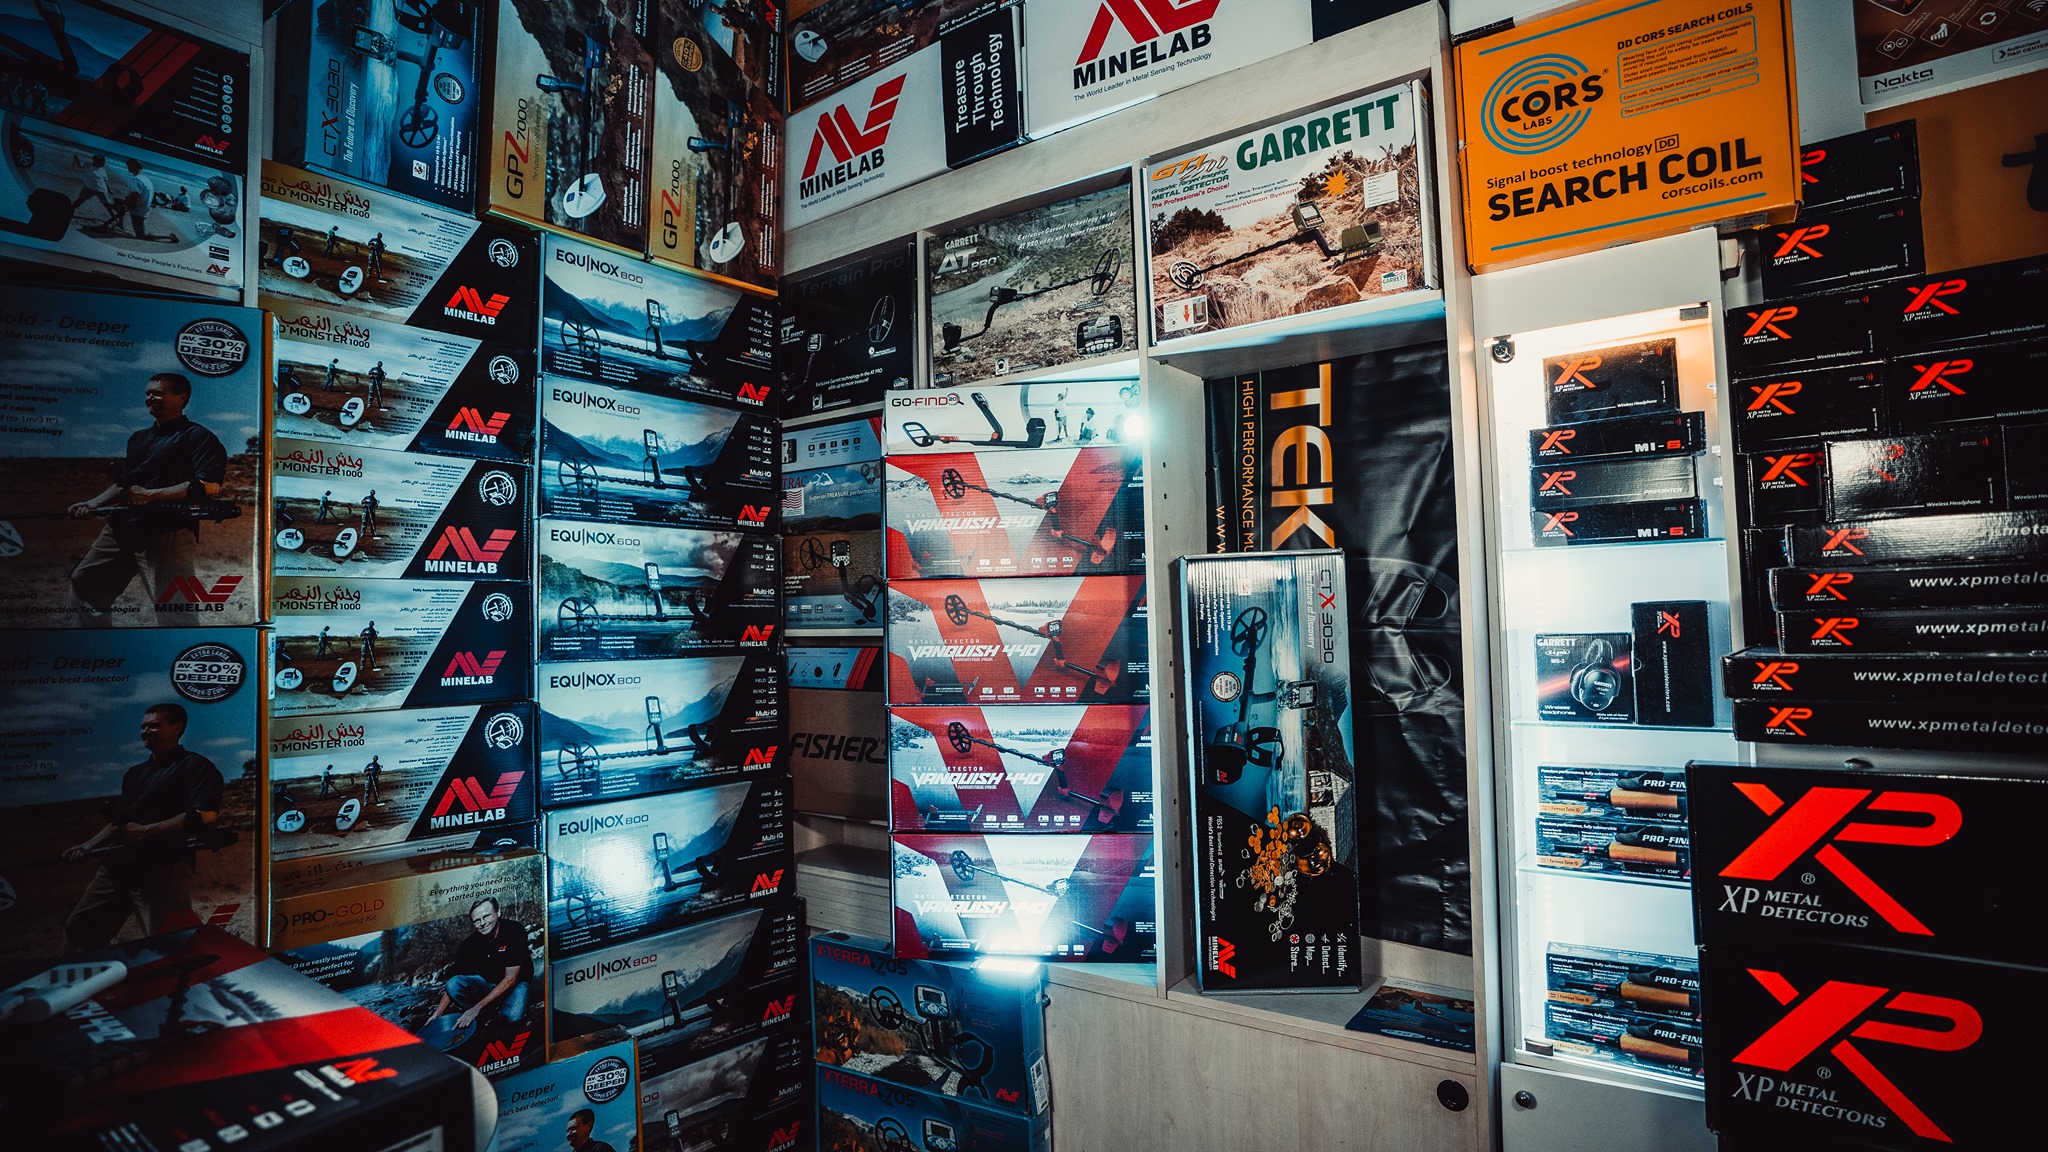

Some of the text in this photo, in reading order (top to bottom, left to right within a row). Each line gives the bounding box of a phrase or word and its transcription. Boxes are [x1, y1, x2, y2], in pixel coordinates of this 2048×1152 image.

[1618, 2, 1753, 50] DD CORS SEARCH COILS
[1622, 52, 1644, 62] Wearing
[1677, 38, 1692, 47] using
[1694, 30, 1724, 43] composite
[1724, 21, 1752, 32] materials
[2006, 40, 2040, 53] Authorized
[1073, 24, 1212, 90] MINELAB
[988, 32, 1004, 131] Technology
[1074, 93, 1085, 101] The
[1086, 88, 1103, 97] World
[1104, 81, 1124, 92] Leader
[1132, 72, 1149, 82] Metal
[1150, 64, 1175, 77] Sensing
[1176, 52, 1212, 68] Technology
[1874, 69, 1934, 90] Nokta
[347, 81, 359, 114] Discovery
[955, 59, 968, 134] Treasure
[969, 52, 986, 125] Through
[1501, 74, 1604, 123] CORS
[1650, 97, 1680, 108] completely
[1680, 88, 1711, 100] waterproof
[516, 98, 528, 140] 7000
[1523, 116, 1553, 131] LABS
[345, 126, 355, 148] Future
[1236, 93, 1400, 171] GARRETT
[194, 143, 224, 155] MINELAB
[1486, 136, 1677, 189] Signal boost technology DD
[799, 148, 885, 200] MINELAB
[1488, 137, 1762, 222] SEARCH COIL
[1151, 175, 1229, 201] METAL DETECTOR
[1661, 169, 1764, 201] corscoils.com
[1845, 186, 1894, 201] Wireless Headphone
[1151, 182, 1230, 209] The Professional's Choice!
[944, 234, 979, 250] GARRETT
[127, 253, 151, 264] Change
[177, 264, 202, 273] Fortunes
[556, 249, 643, 284] EQUINOX 800
[934, 247, 997, 280] AT PRO
[1849, 263, 1898, 277] Wireless Headphone
[59, 315, 130, 334] Deeper
[444, 306, 496, 325] MINELAB
[24, 333, 62, 342] world's
[65, 335, 85, 343] best
[89, 337, 134, 348] detector!
[736, 395, 764, 407] MINELAB
[891, 396, 948, 407] GO-FIND
[1242, 380, 1255, 419] HIGH
[282, 462, 363, 478] MONSTER 1000
[1242, 421, 1255, 528] PERFORMANCE
[903, 516, 998, 535] VANQUISH
[550, 528, 641, 546] EQUINOX 600
[425, 560, 498, 574] MINELAB
[80, 606, 141, 614] Technologies
[154, 603, 224, 612] MINELAB
[279, 602, 338, 611] MONSTER
[1322, 612, 1334, 664] 3030
[1915, 620, 2048, 636] www.xpmetal
[1537, 638, 1576, 647] GARRETT
[907, 644, 1042, 662] VANQUISH 440
[176, 674, 237, 682] DEEPER
[441, 675, 493, 687] MINELAB
[550, 671, 641, 690] EQUINOX 800
[743, 762, 771, 772] MINELAB
[910, 772, 1046, 788] VANQUISH 440
[430, 884, 469, 896] Everything
[470, 882, 484, 890] you
[485, 876, 503, 886] need
[512, 873, 524, 881] get
[292, 899, 384, 926] PRO-GOLD
[1718, 884, 1869, 928] XP METAL DETECTORS
[292, 922, 331, 936] Premium
[332, 917, 364, 930] Panning
[1211, 935, 1219, 971] MINELAB
[565, 954, 657, 987] EQUINOX 800
[761, 1012, 791, 1028] MINELAB
[1731, 1070, 1887, 1129] XP METAL DETECTORS
